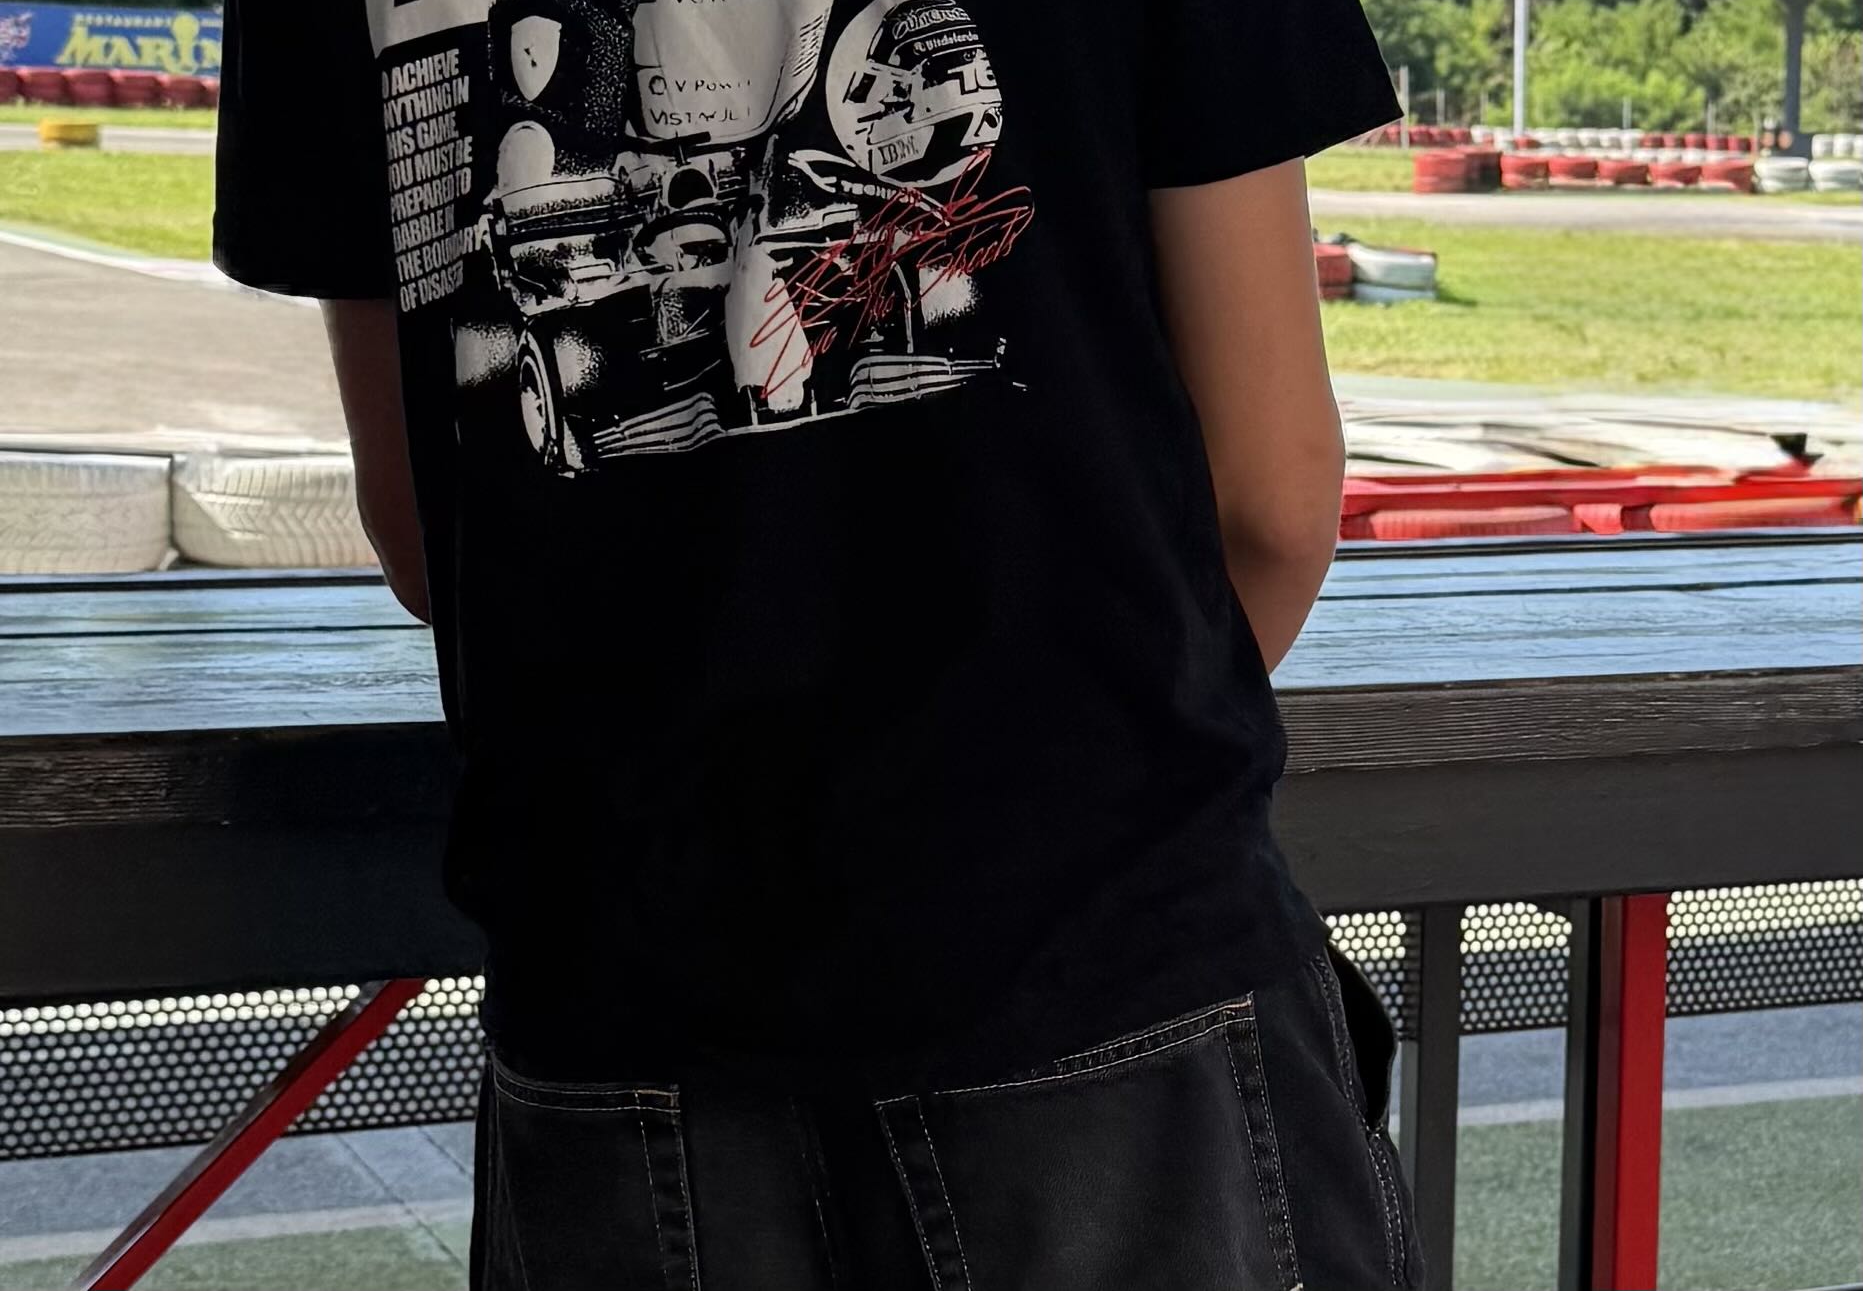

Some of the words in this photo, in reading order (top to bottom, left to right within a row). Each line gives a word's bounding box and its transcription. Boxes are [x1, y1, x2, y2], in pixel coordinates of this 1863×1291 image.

[391, 48, 460, 96] ACHIEVE
[384, 82, 452, 130] NYTHING
[452, 75, 470, 107] IN
[386, 125, 416, 160] HIS
[416, 111, 459, 150] GAME
[388, 158, 414, 193] OU
[414, 142, 455, 182] MUST
[455, 167, 472, 198] TO
[392, 209, 445, 254] DABBLE
[396, 249, 424, 283] THE
[400, 282, 418, 313] OF
